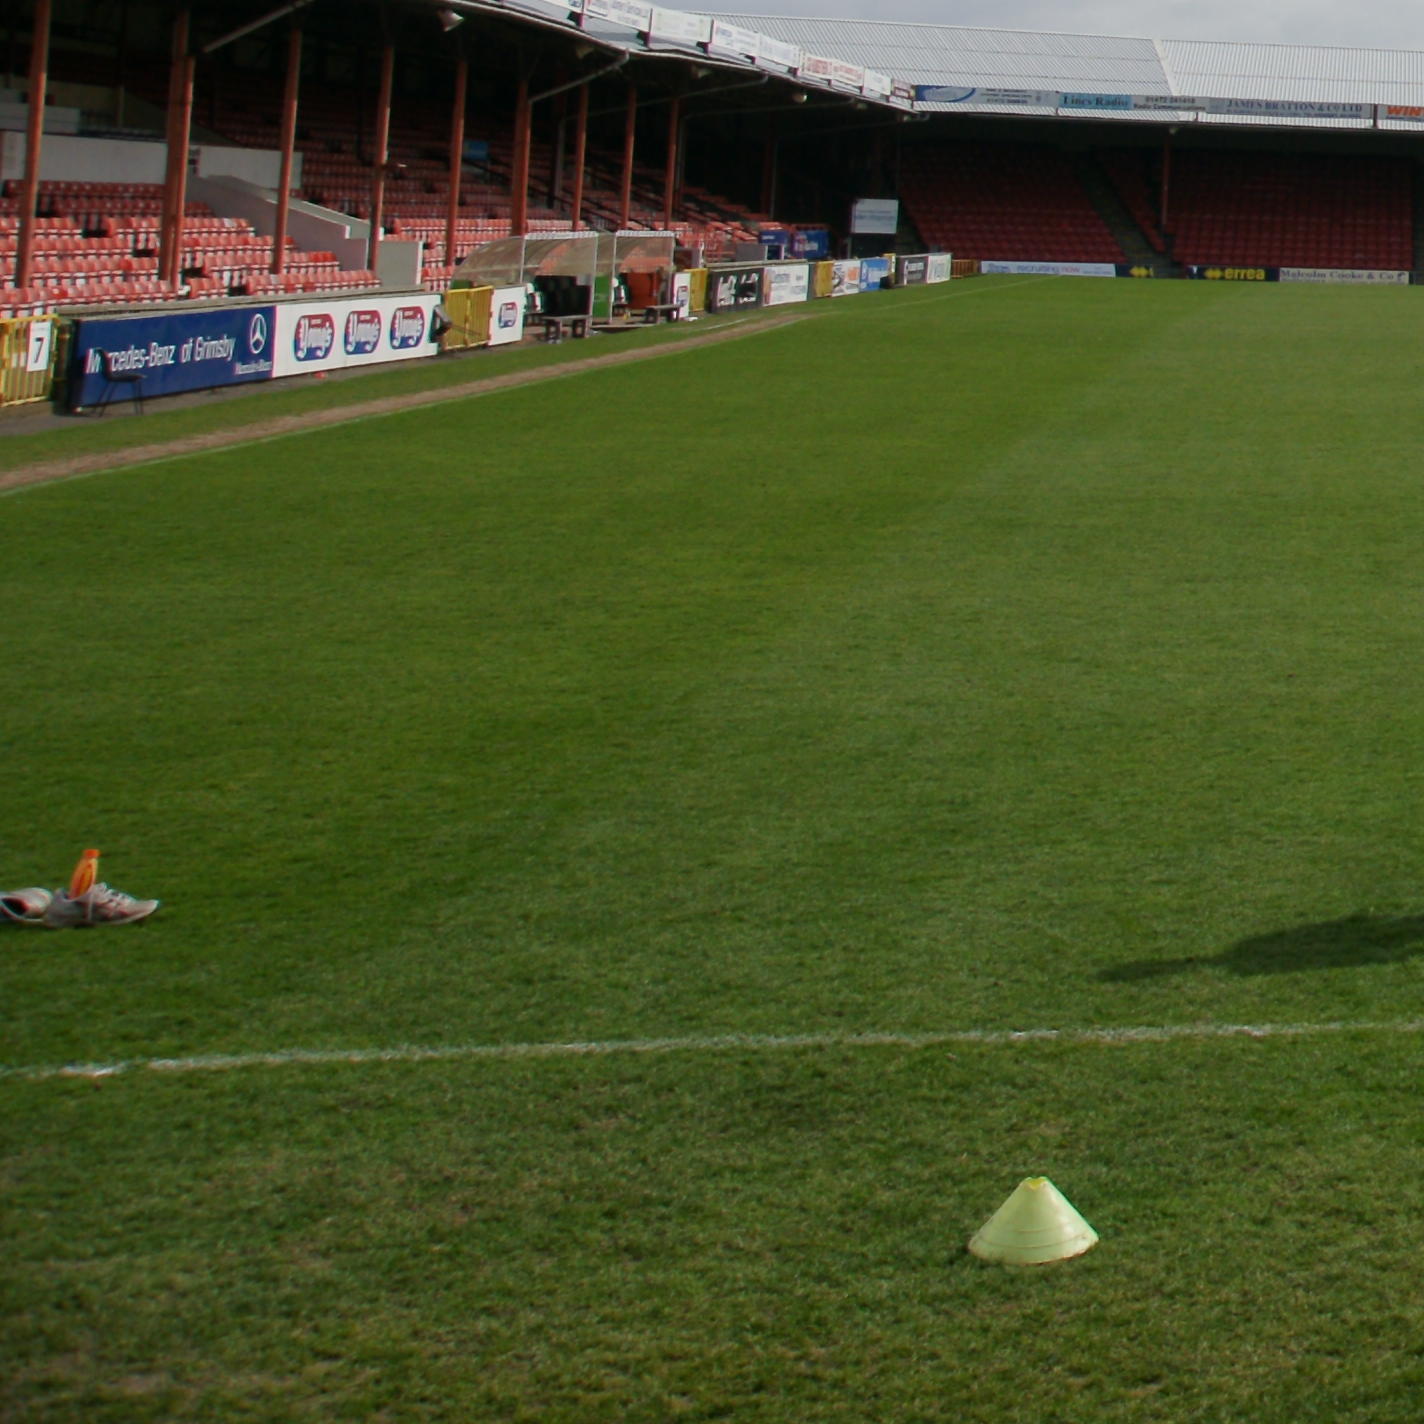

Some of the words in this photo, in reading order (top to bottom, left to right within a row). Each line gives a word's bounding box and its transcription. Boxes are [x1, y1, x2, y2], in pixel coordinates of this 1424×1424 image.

[1063, 96, 1092, 105] Lincs
[1095, 96, 1128, 106] Radio
[1281, 269, 1327, 279] Malcolm
[298, 316, 333, 359] Young's
[346, 311, 381, 352] Young's
[392, 308, 423, 347] Young's
[34, 337, 45, 364] 7
[86, 342, 176, 374] Mrcedes-Benz
[181, 337, 194, 363] of
[194, 334, 236, 362] Grimsby
